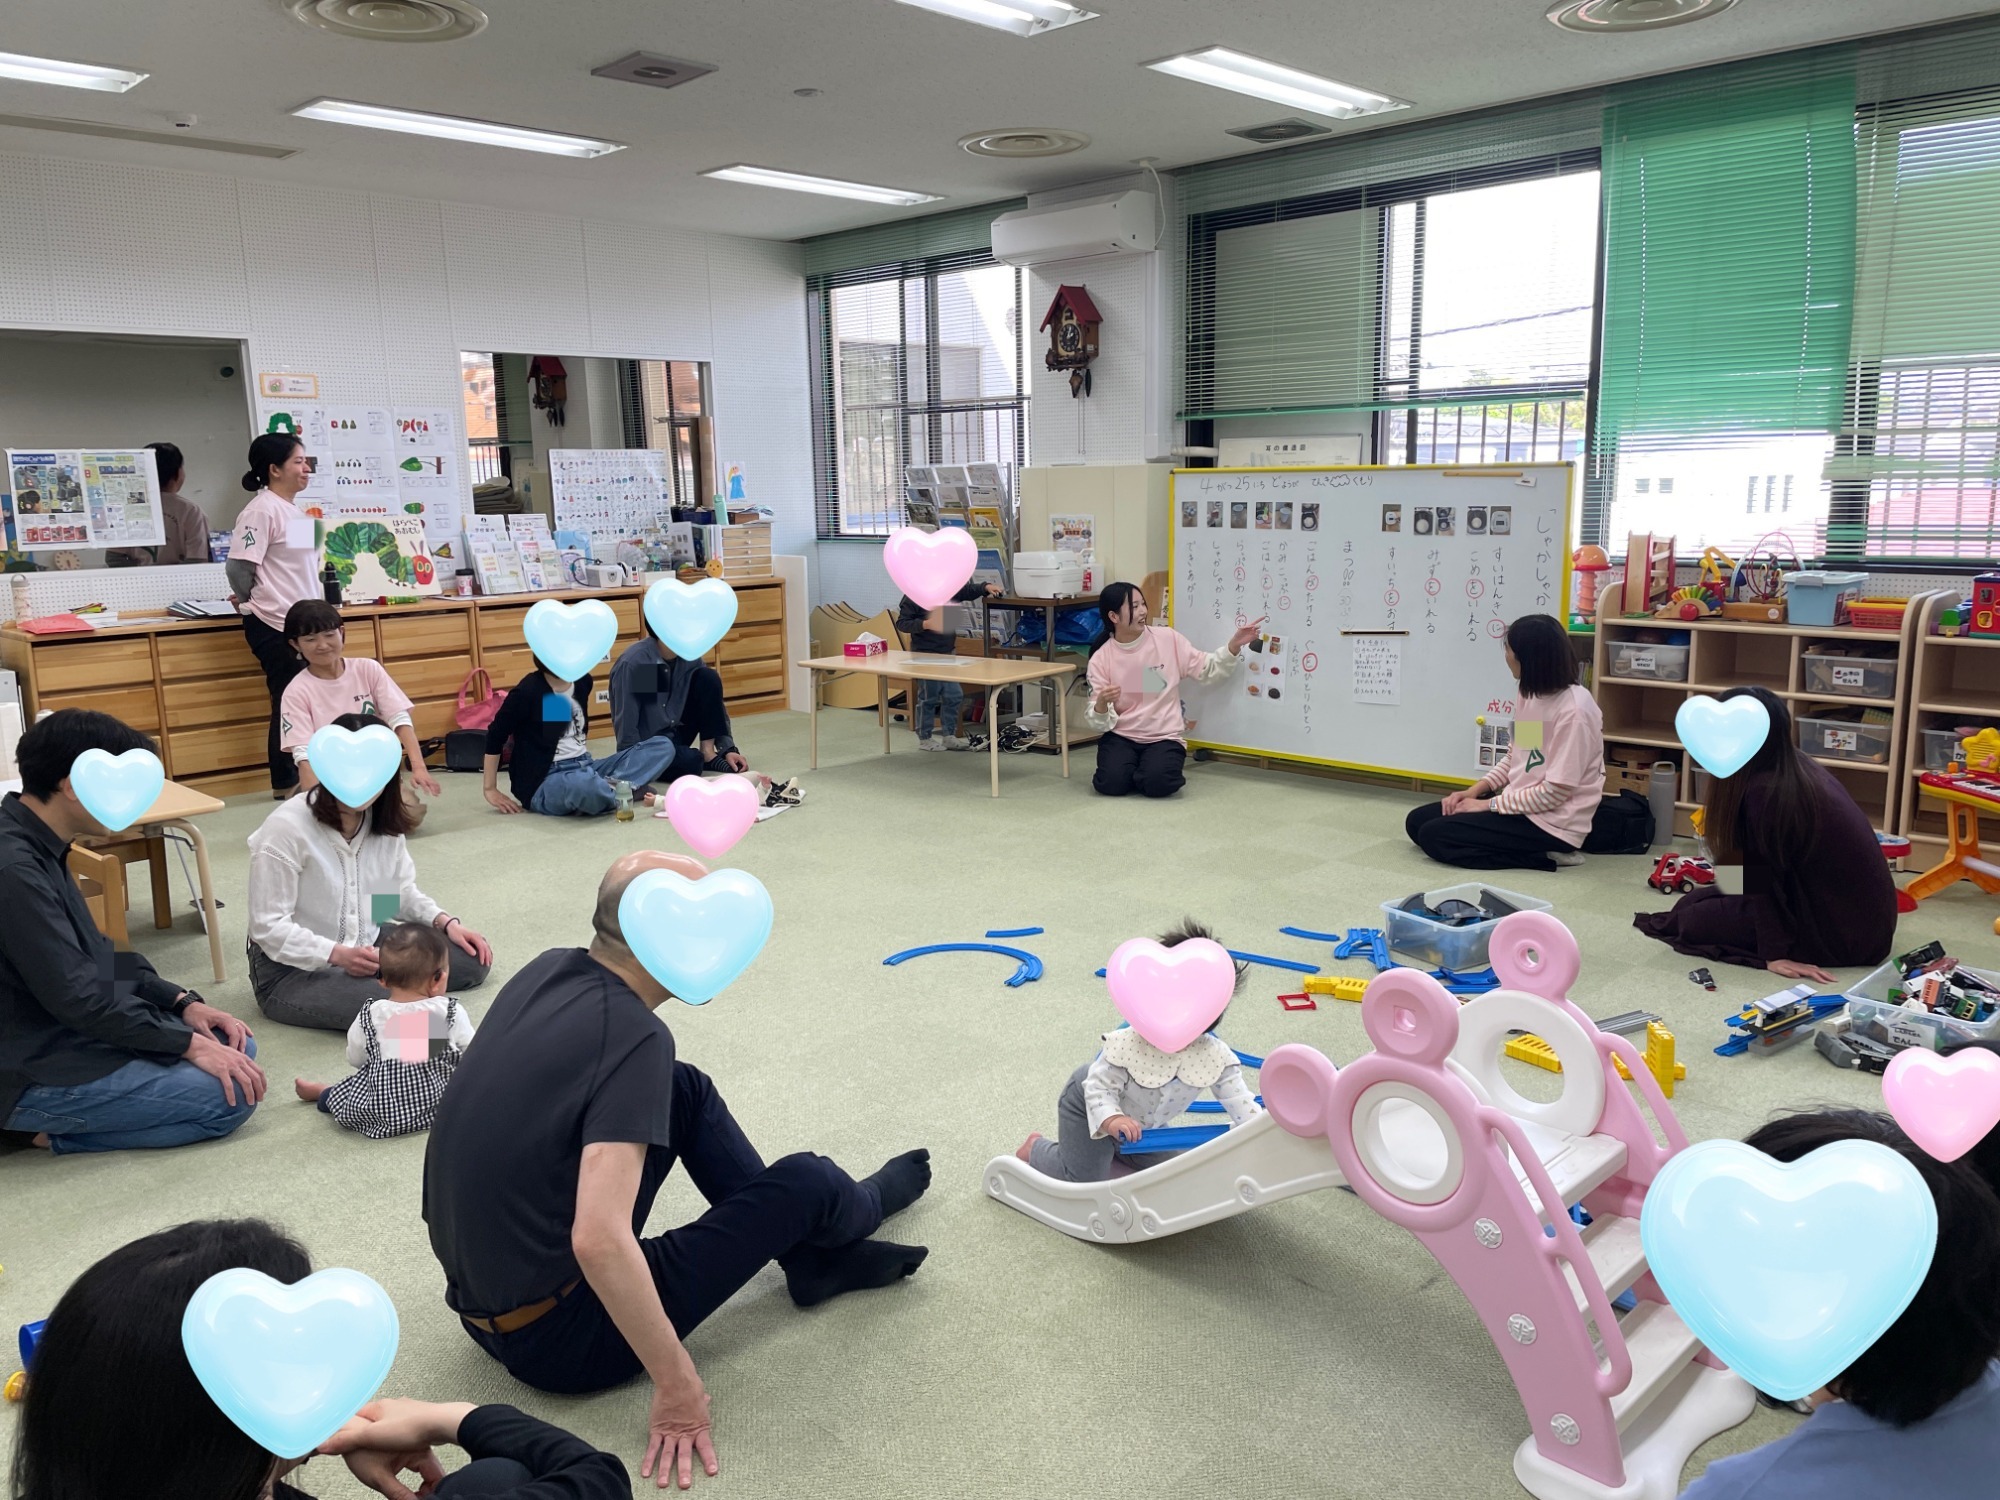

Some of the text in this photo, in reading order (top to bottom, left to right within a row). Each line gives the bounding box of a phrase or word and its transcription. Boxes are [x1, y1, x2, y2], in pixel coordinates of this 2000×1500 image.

[392, 519, 419, 527] はらぺこ
[394, 527, 420, 535] あおむし
[1536, 508, 1557, 616] 「しゃかしゃか
[1425, 548, 1441, 634] みずをいれる
[1466, 550, 1480, 642] こめをいれる
[1487, 698, 1515, 714] 成分
